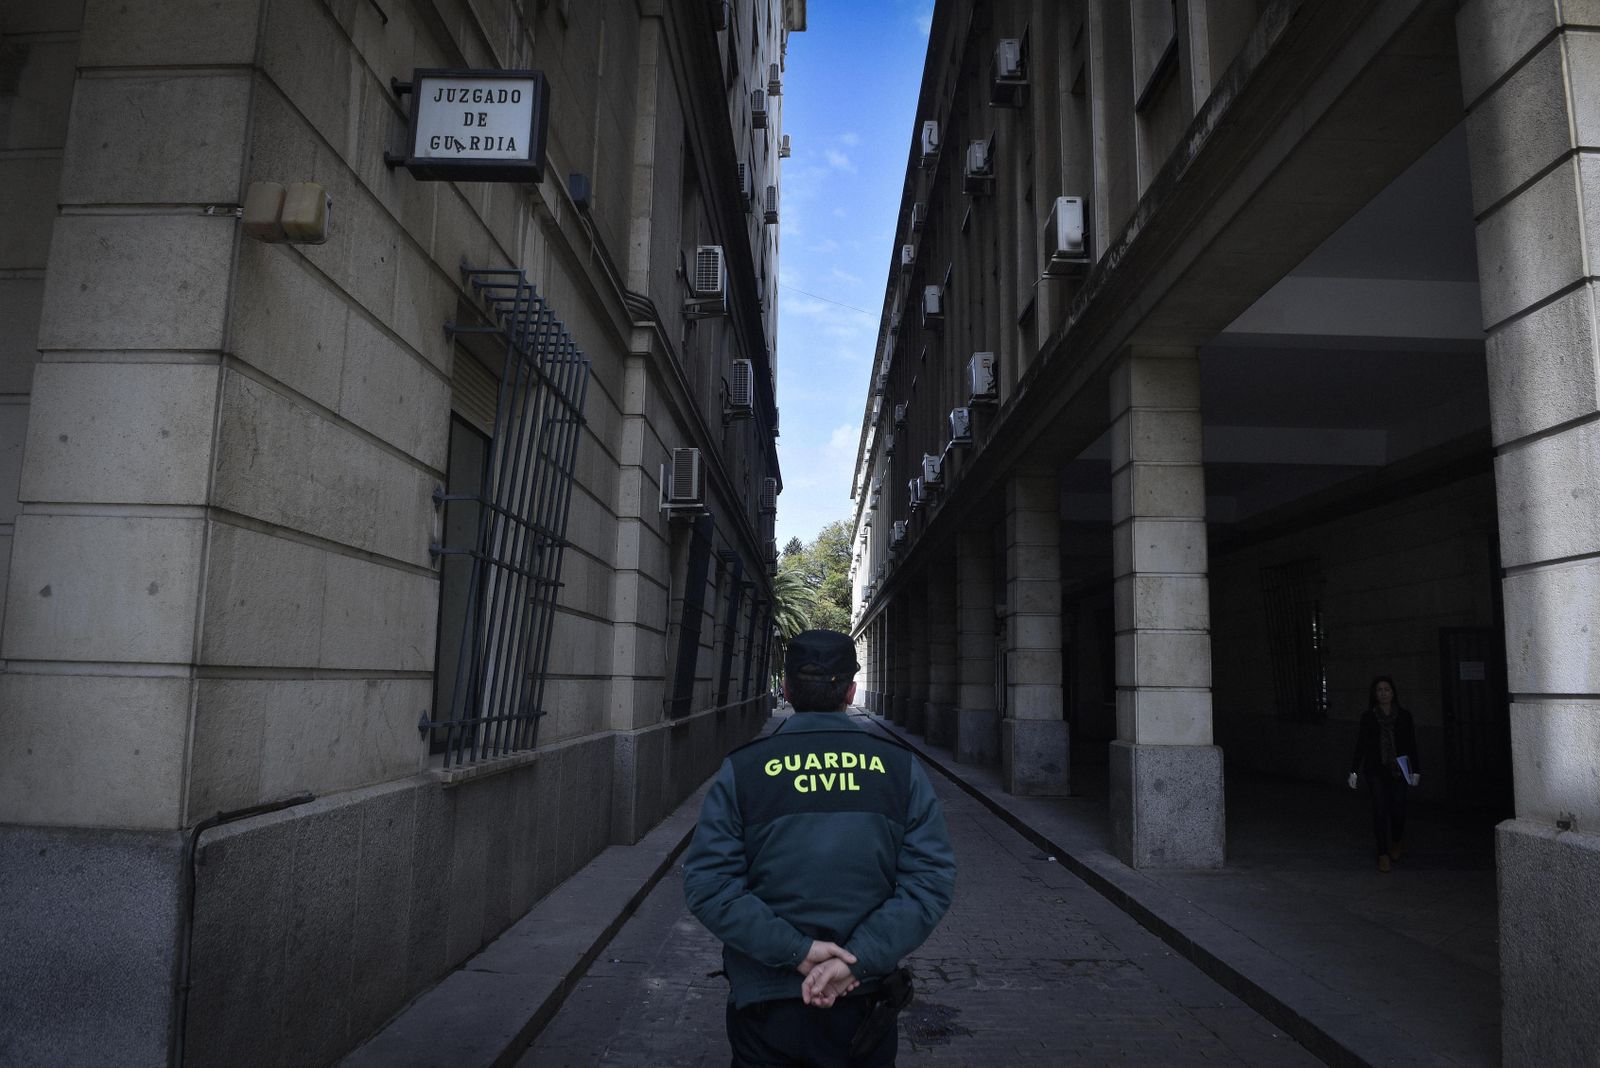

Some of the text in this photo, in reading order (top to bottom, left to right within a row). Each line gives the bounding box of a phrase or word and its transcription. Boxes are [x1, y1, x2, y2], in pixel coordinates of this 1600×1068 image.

[434, 88, 521, 104] JUZGADO
[463, 112, 488, 127] DE
[430, 135, 517, 153] GUARDIA
[764, 751, 886, 776] GUARDIA
[794, 772, 860, 793] CIVIL
